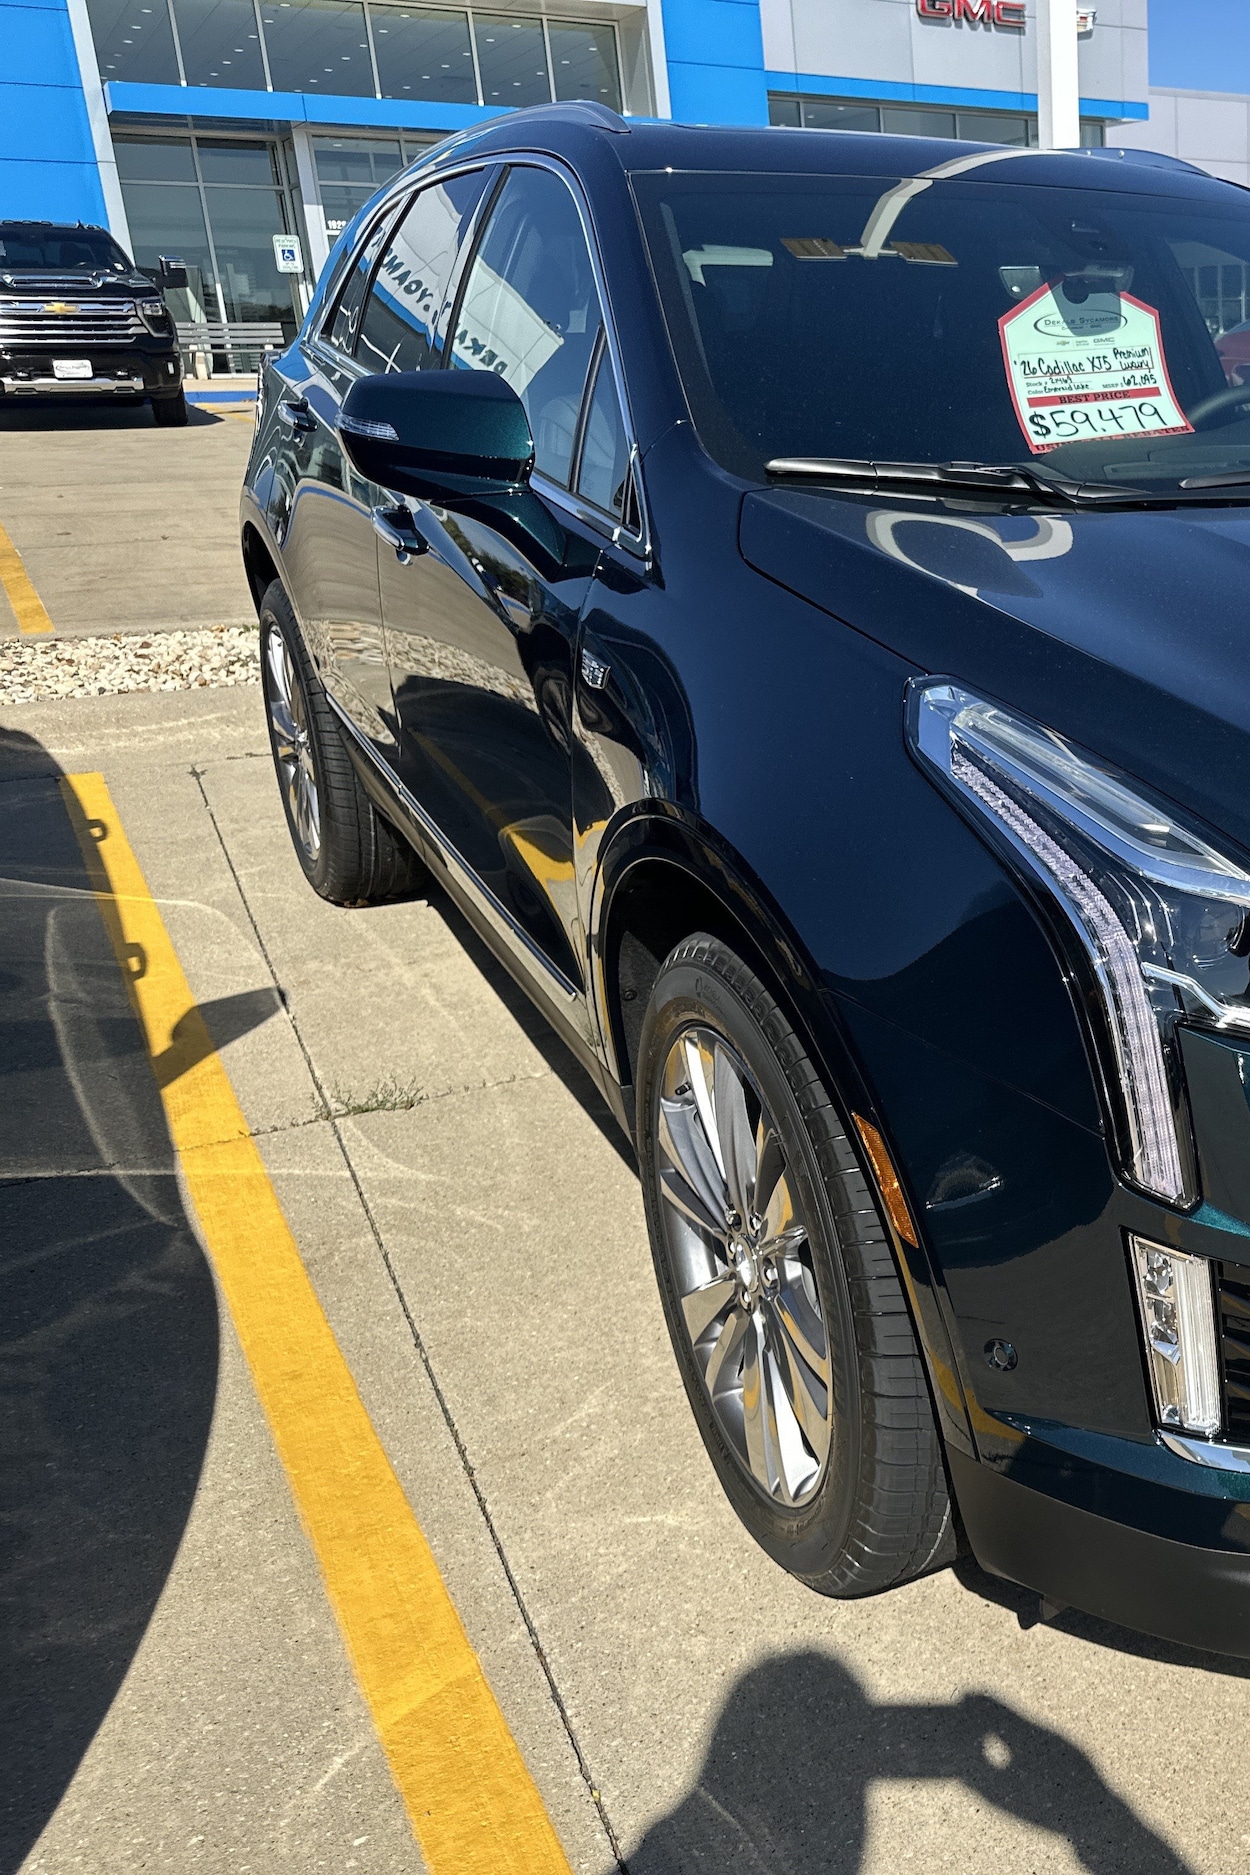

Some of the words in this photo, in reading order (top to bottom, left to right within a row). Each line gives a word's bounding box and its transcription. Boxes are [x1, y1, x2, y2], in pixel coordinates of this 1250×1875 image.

[916, 0, 1026, 28] GMC
[1113, 347, 1149, 361] Premium
[1037, 356, 1085, 376] Cadillac
[1086, 355, 1112, 371] XT5
[1058, 394, 1091, 404] BEST
[1093, 390, 1131, 400] PRICE
